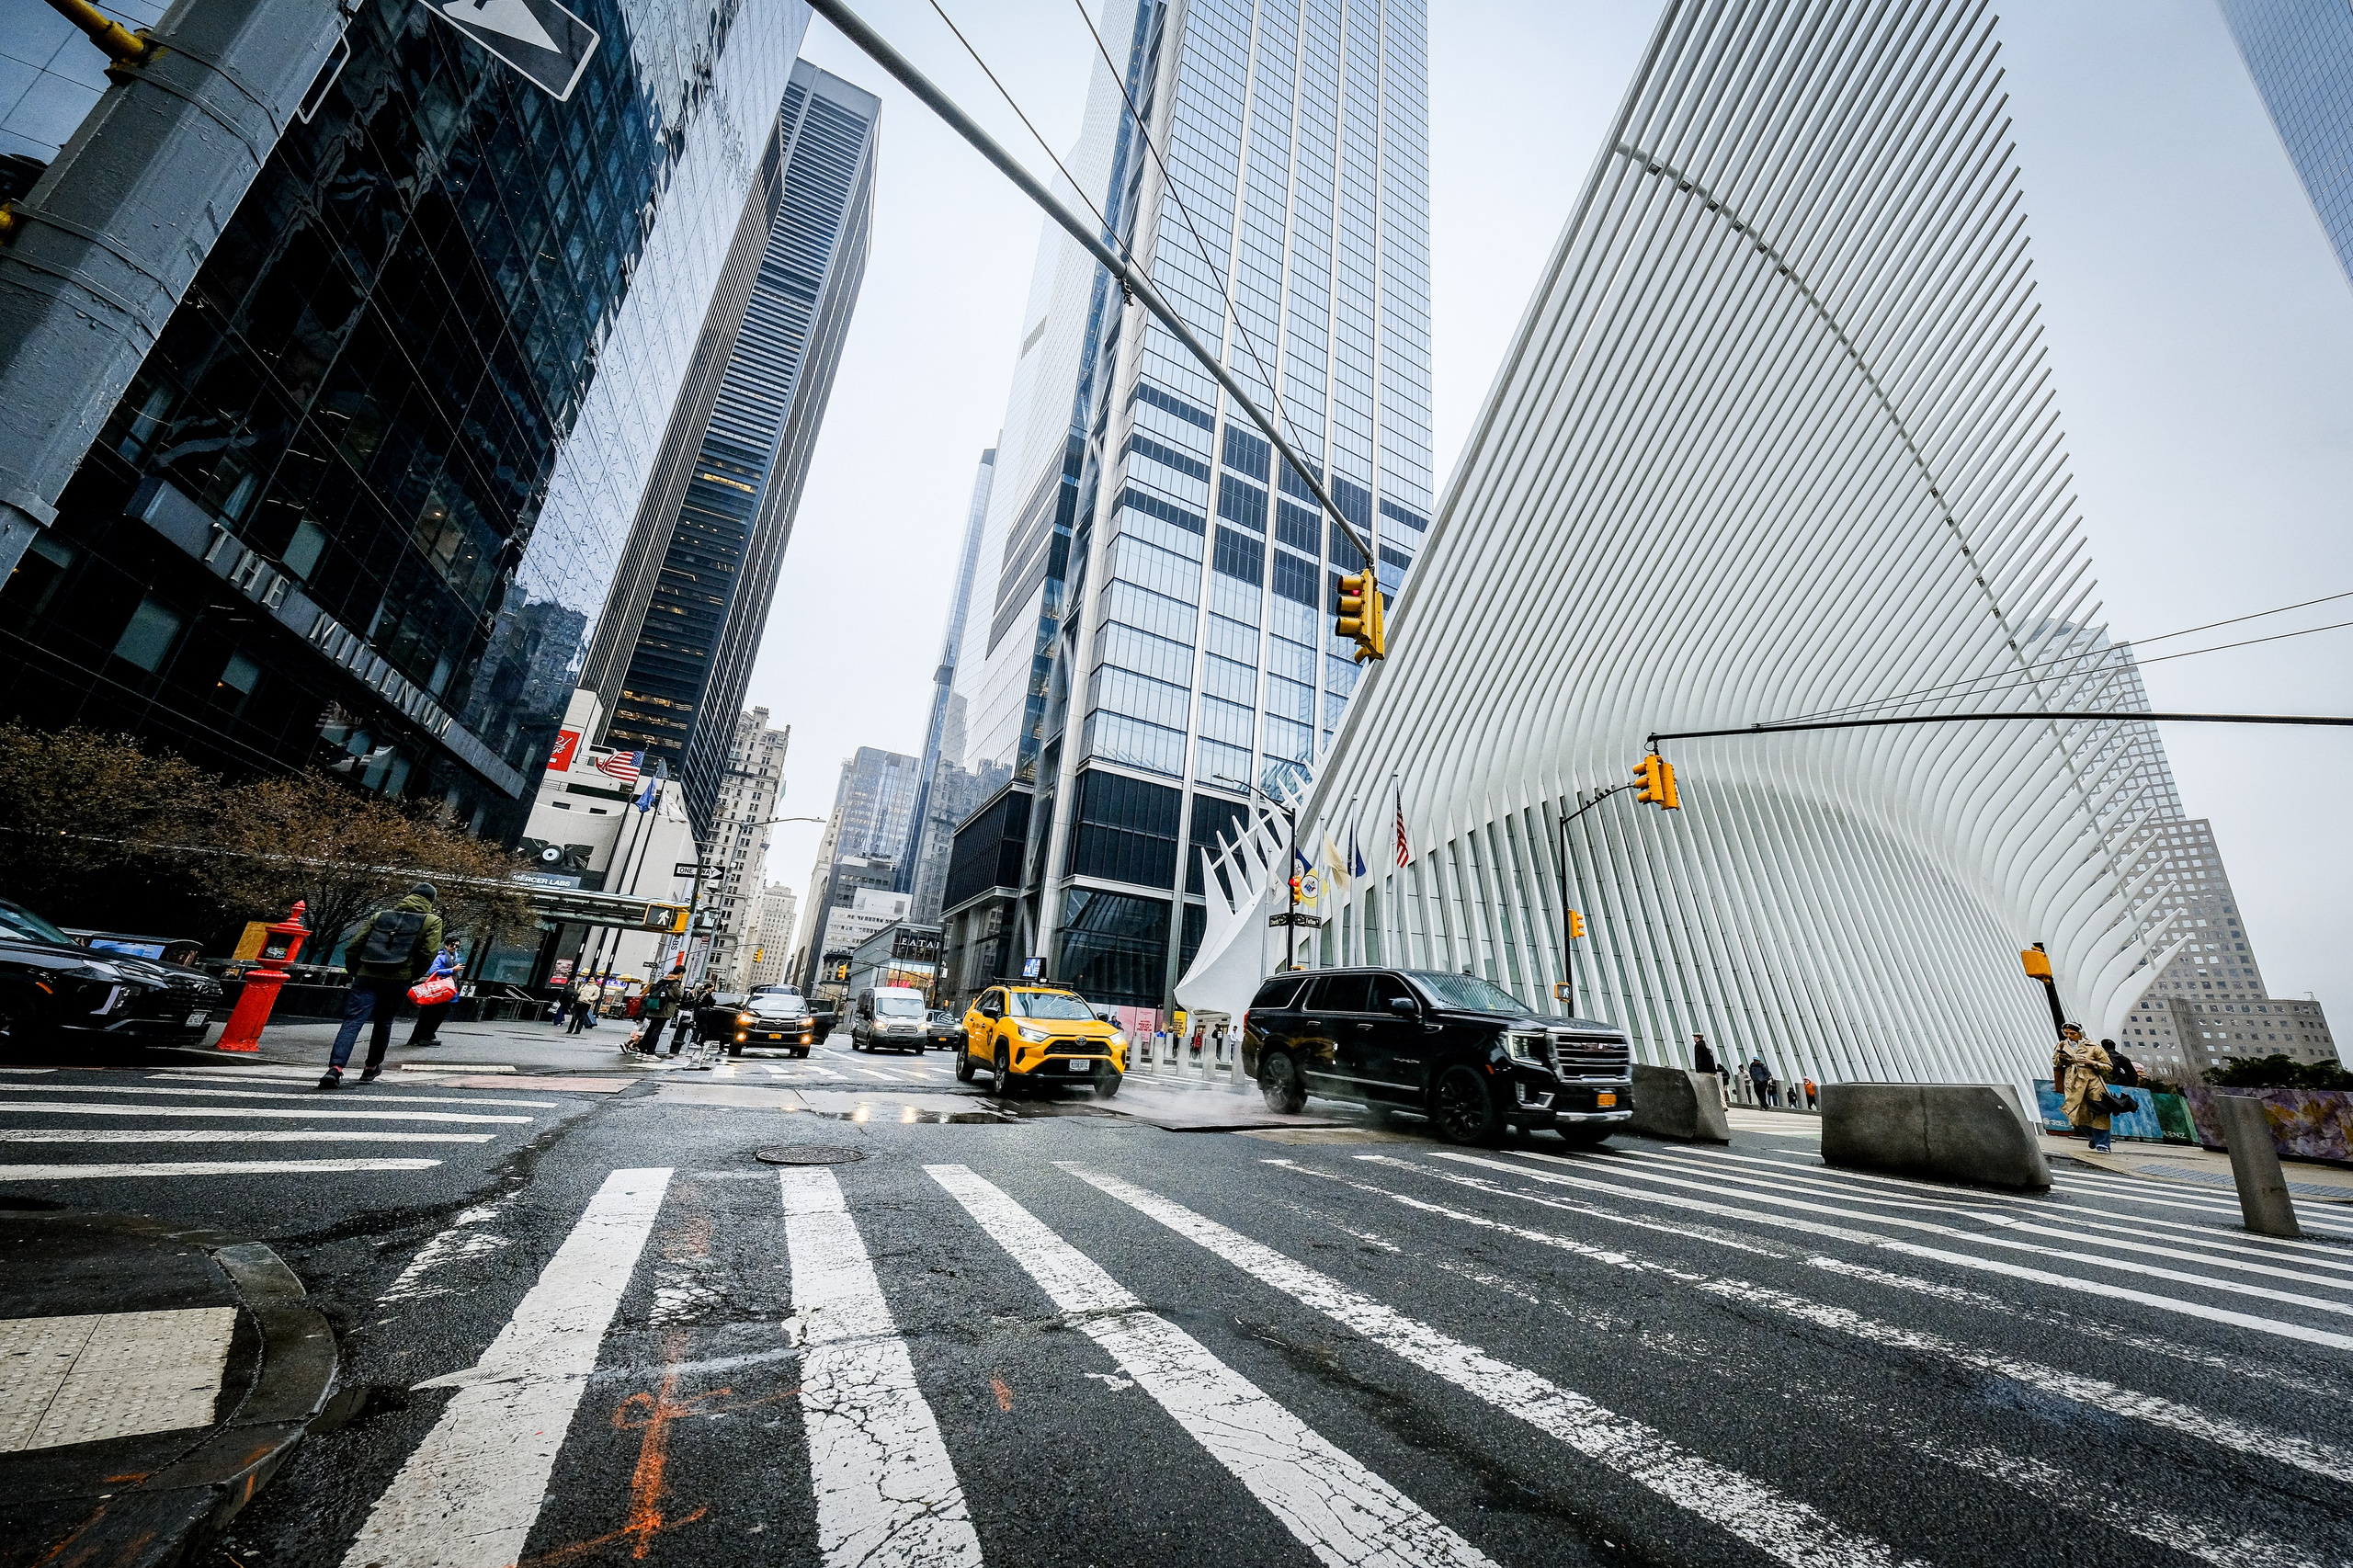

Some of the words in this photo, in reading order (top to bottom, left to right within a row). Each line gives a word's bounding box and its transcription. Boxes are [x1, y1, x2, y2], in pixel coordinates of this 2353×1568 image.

[205, 523, 290, 612] THE
[309, 612, 453, 740] MILLENIUM
[512, 874, 548, 884] MERCER
[549, 879, 571, 887] LABS
